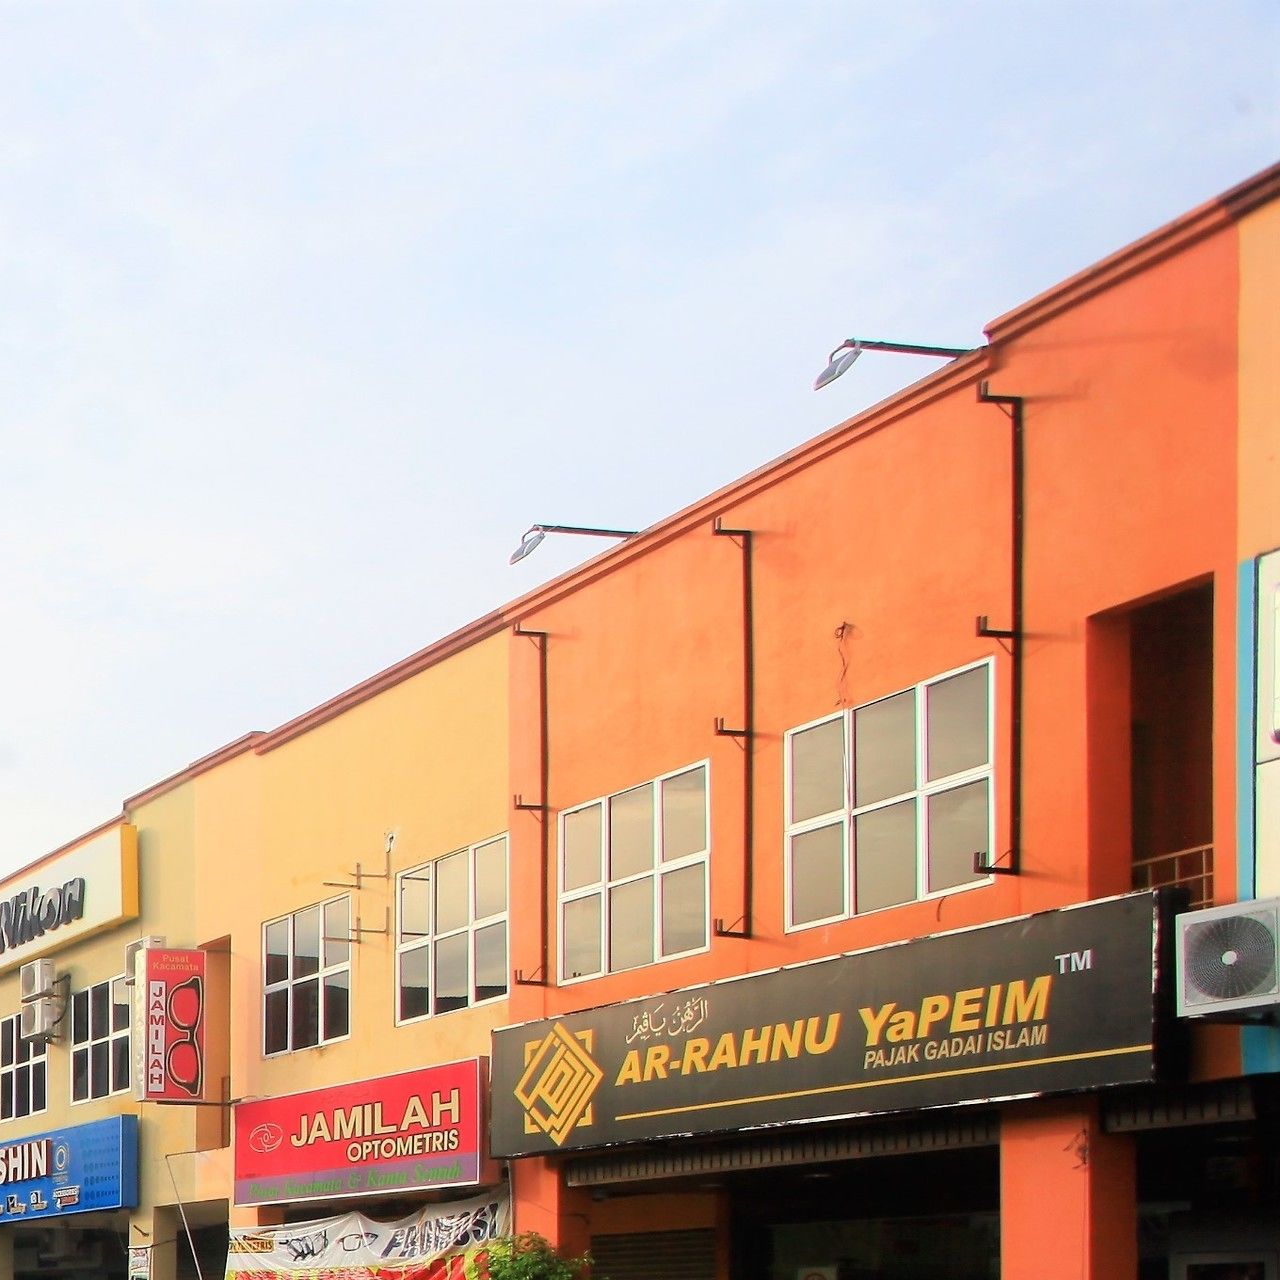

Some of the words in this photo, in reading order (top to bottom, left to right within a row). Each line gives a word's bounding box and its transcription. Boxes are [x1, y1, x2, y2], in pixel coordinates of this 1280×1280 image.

[152, 962, 199, 972] Kacamata
[162, 953, 190, 963] Pusat
[1054, 949, 1093, 975] TM
[150, 986, 165, 1085] JAMILAH
[614, 1012, 842, 1087] AR-RAHNU
[858, 974, 1054, 1047] YaPEIM
[863, 1043, 920, 1070] PAJAK
[924, 1033, 984, 1060] GADAI
[987, 1024, 1048, 1052] ISLAM
[290, 1088, 461, 1147] JAMILAH
[346, 1128, 460, 1162] OPTOMETRIS
